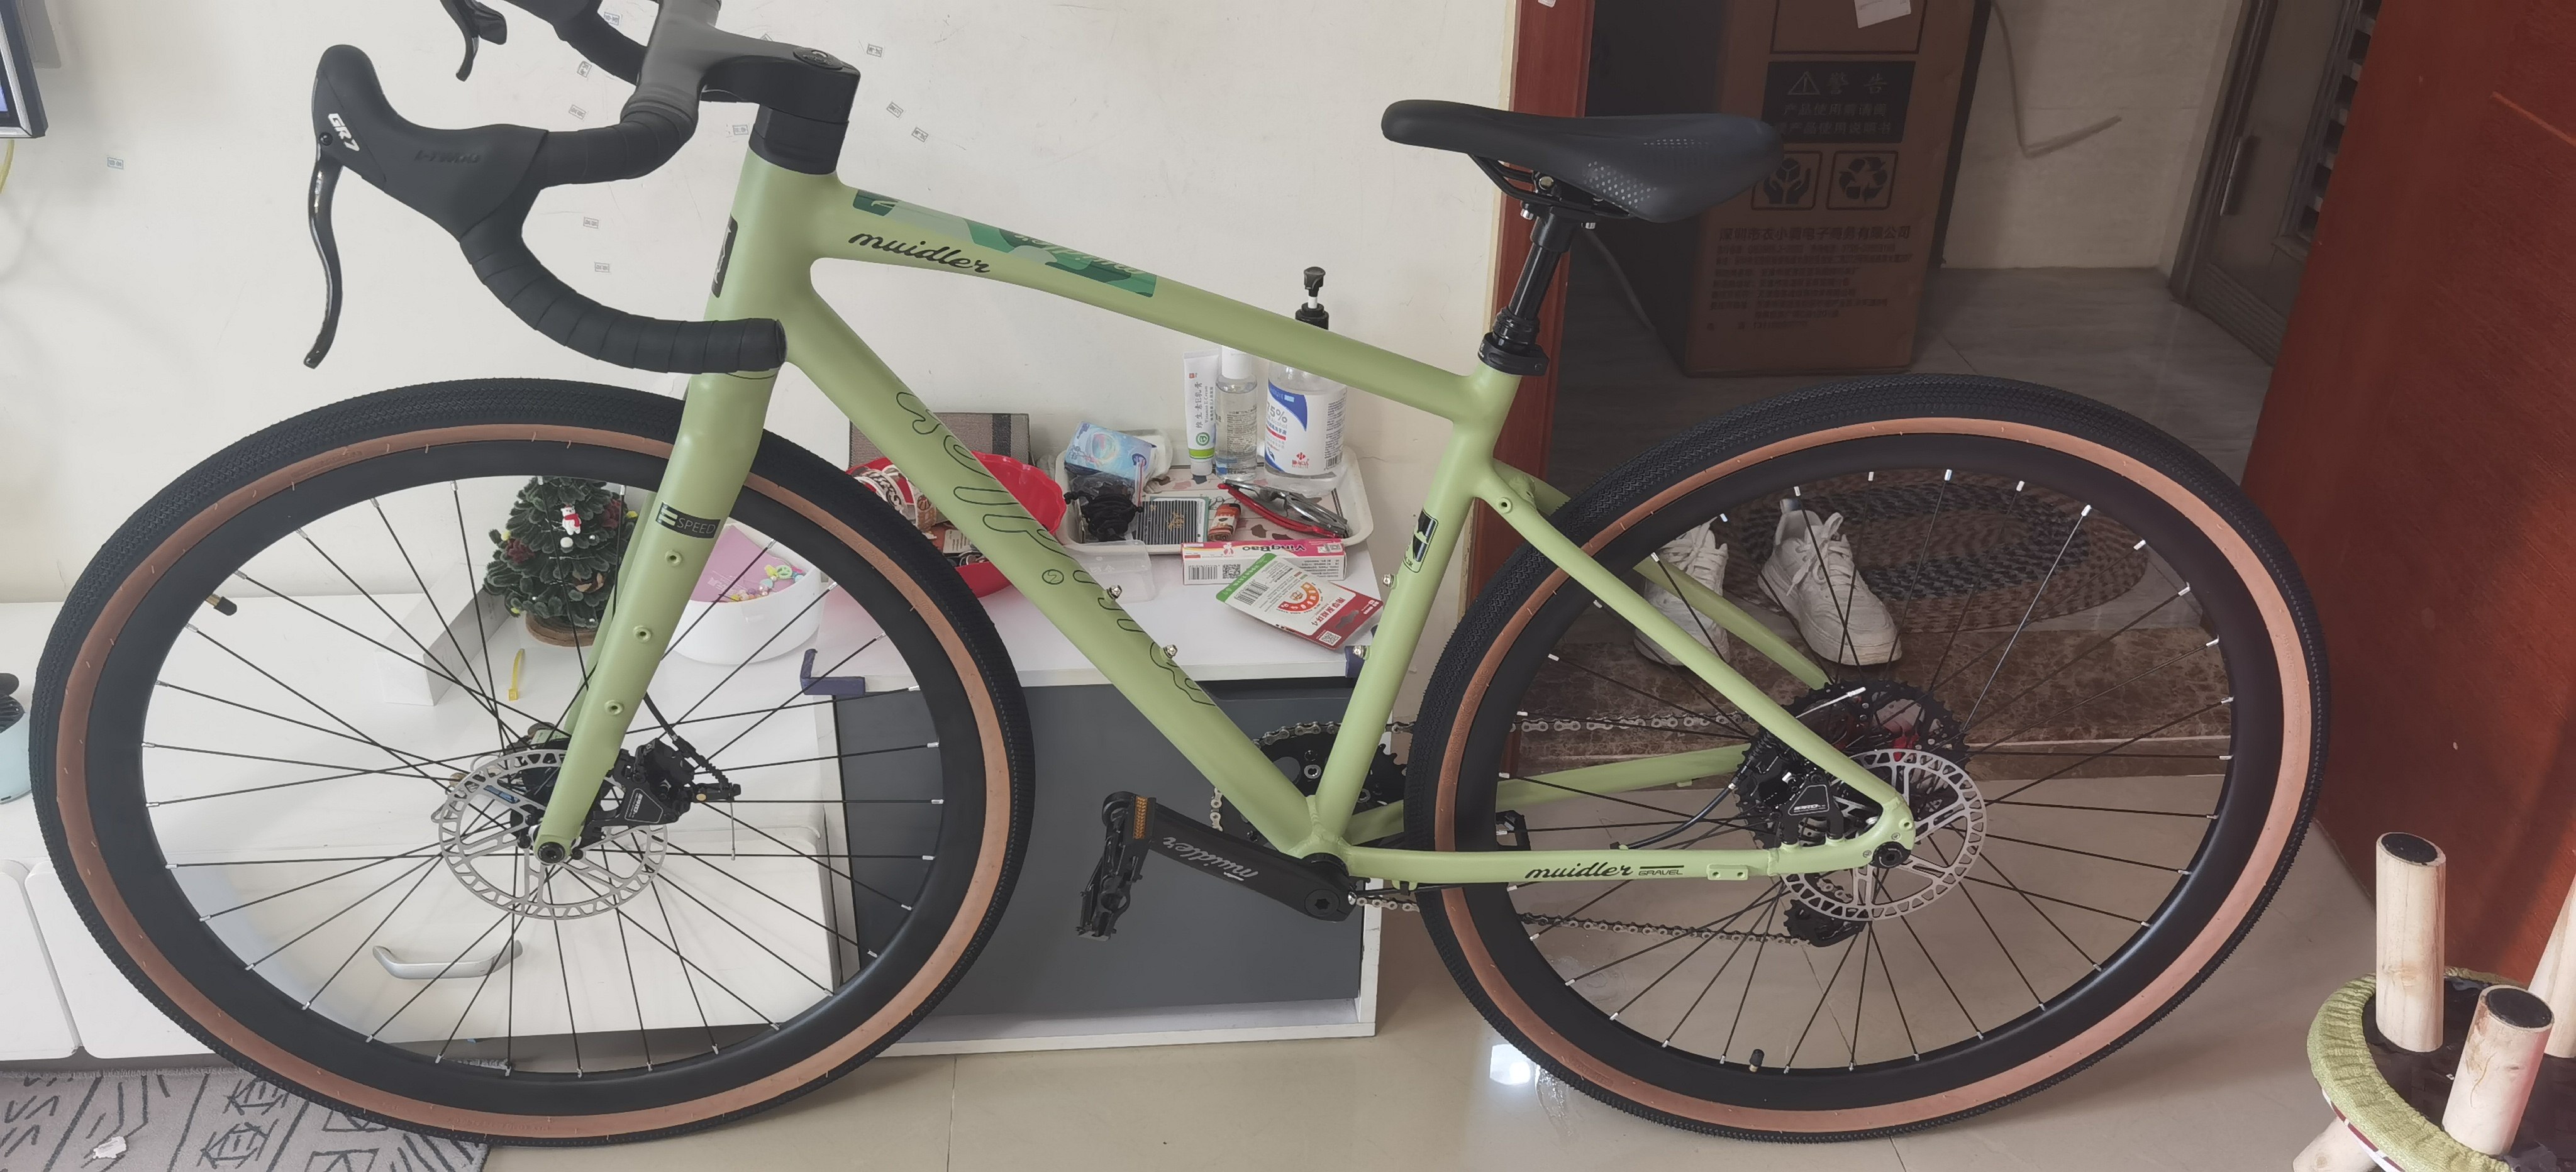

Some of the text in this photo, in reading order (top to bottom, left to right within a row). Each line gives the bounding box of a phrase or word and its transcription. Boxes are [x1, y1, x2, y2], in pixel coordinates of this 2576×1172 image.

[1826, 71, 1887, 95] 警告
[328, 113, 360, 152] GR7
[848, 231, 991, 274] muidler
[677, 517, 716, 534] SPEED
[1241, 544, 1306, 553] YingBao
[1524, 861, 1634, 879] muidler
